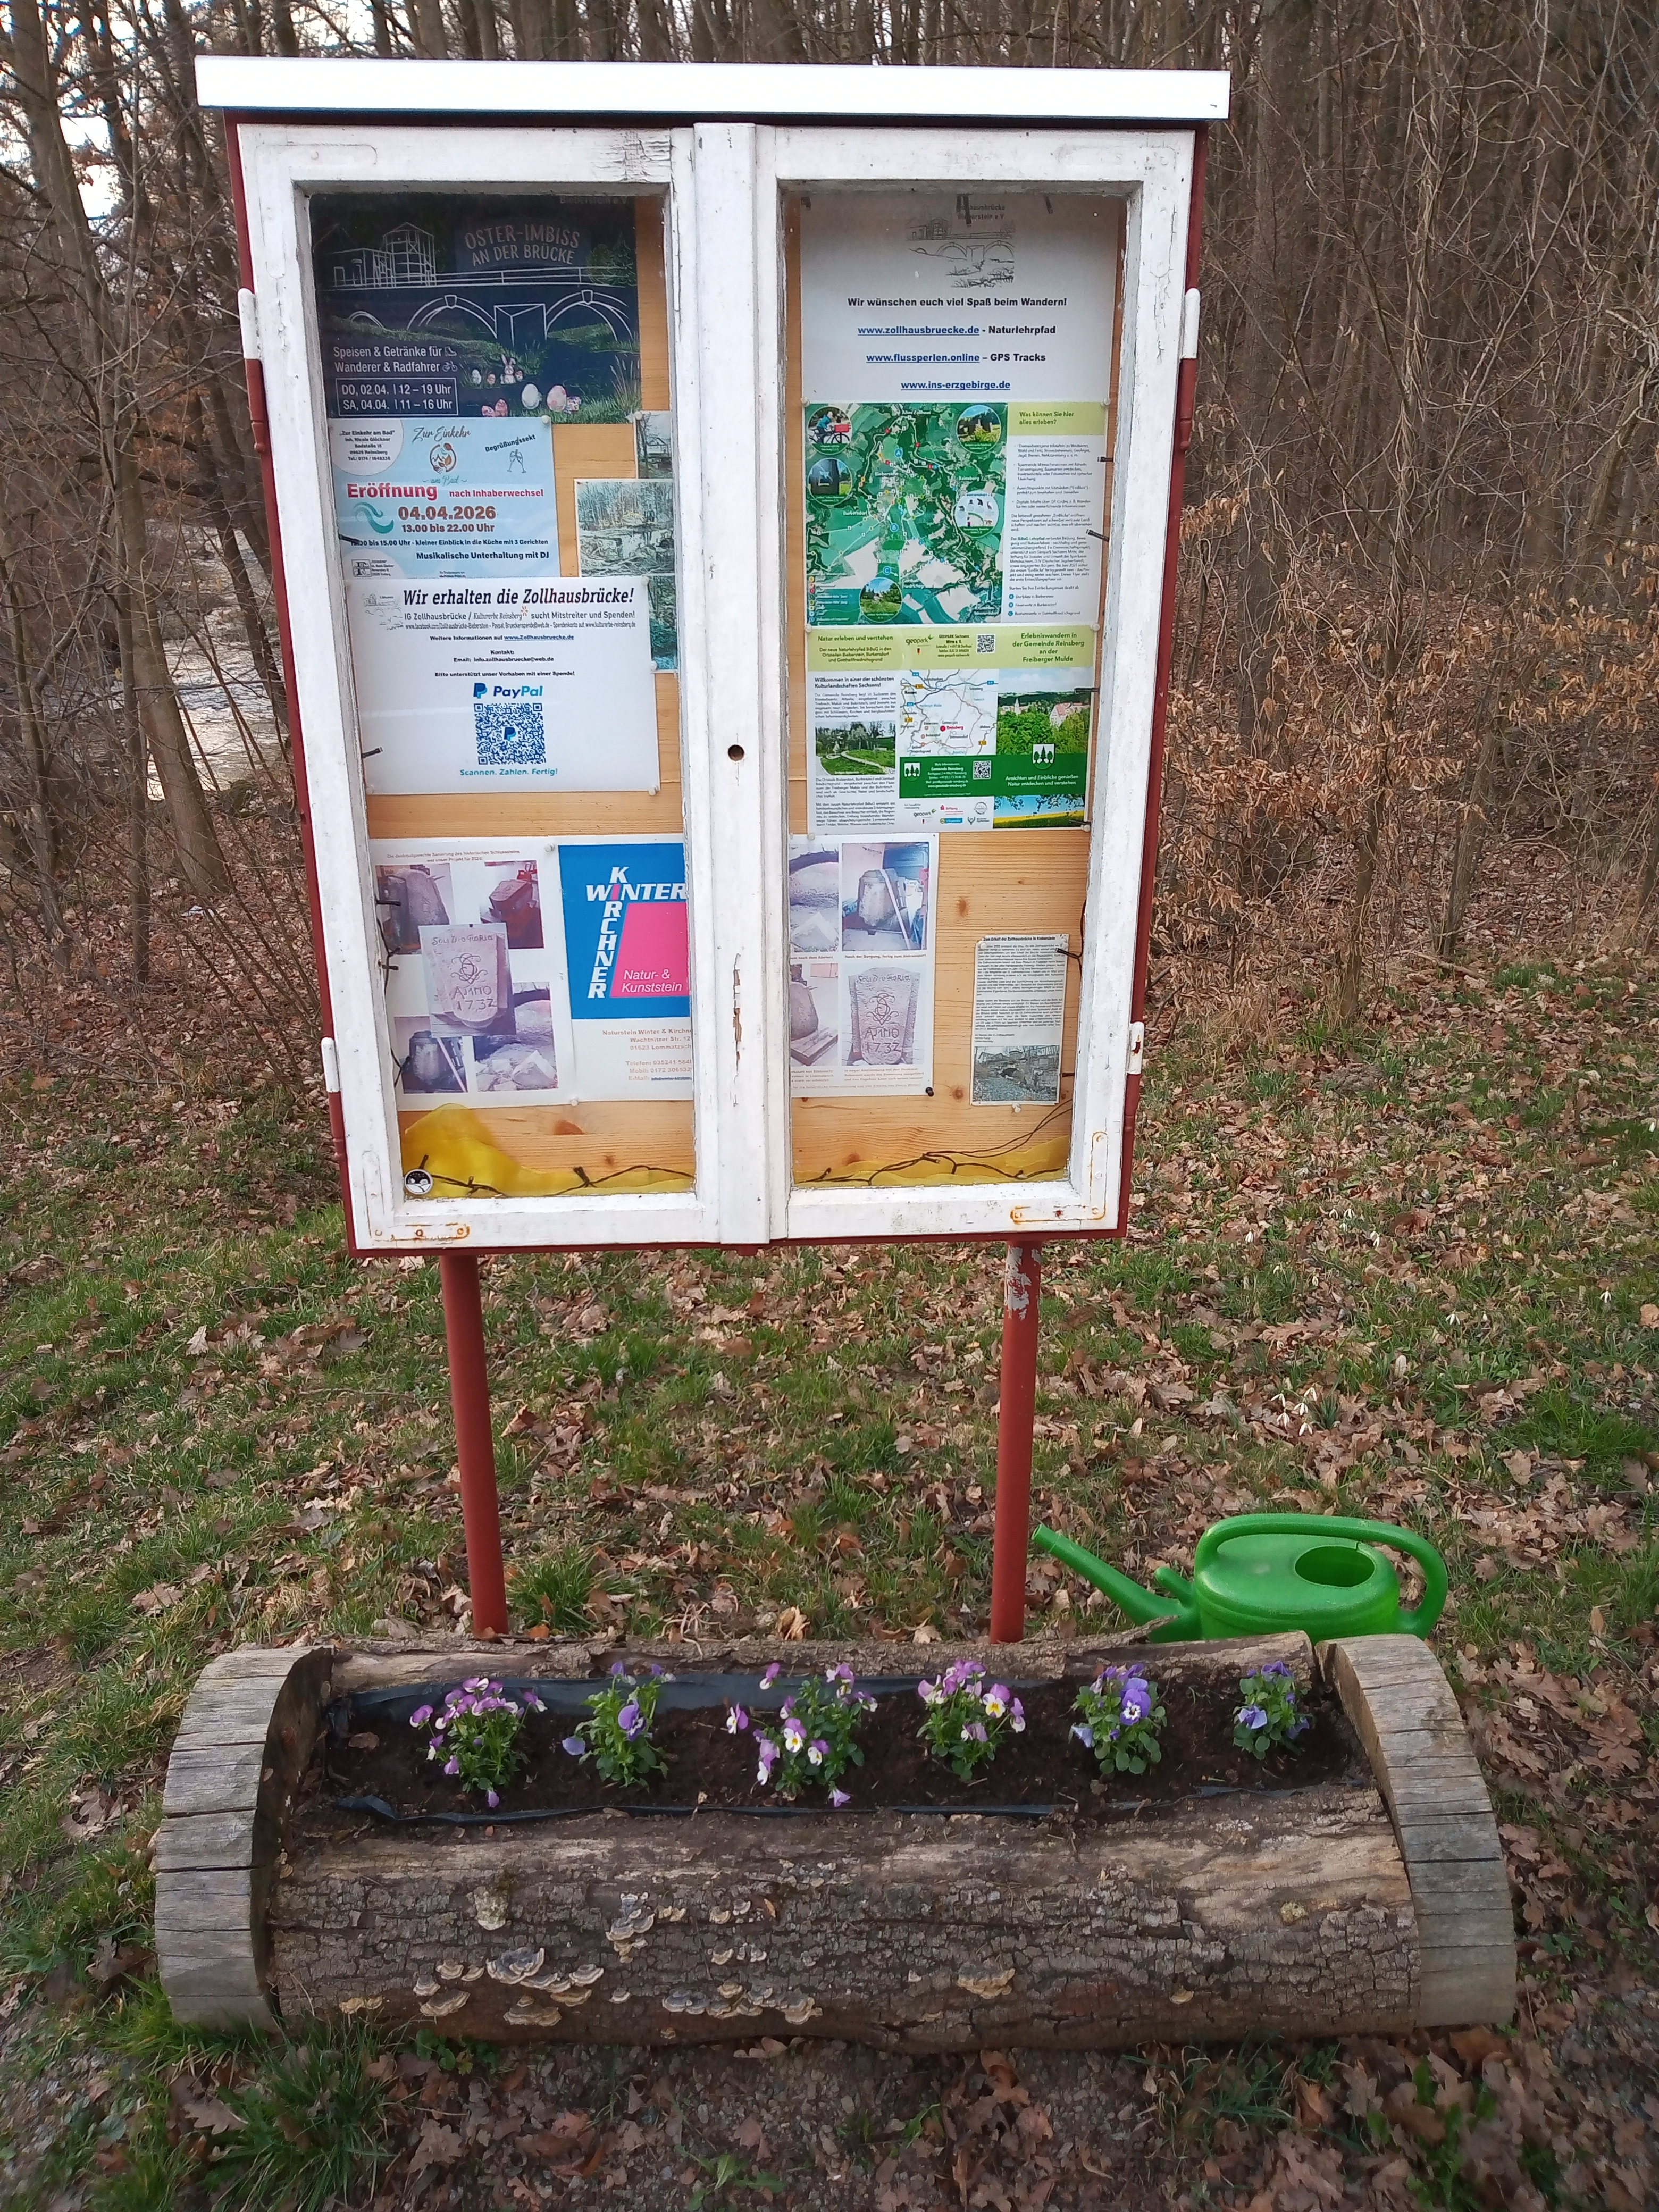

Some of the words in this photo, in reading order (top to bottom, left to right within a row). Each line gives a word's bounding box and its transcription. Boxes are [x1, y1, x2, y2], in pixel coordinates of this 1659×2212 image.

[465, 224, 580, 249] OSTER-IMBISS
[472, 249, 490, 266] AN
[493, 244, 519, 261] DER
[524, 242, 575, 265] BRÜCKE
[847, 297, 865, 307] Wir
[867, 297, 917, 307] wünschen
[919, 297, 944, 307] euch
[946, 297, 964, 306] viel
[967, 297, 991, 309] Spaß
[994, 297, 1018, 306] beim
[1020, 297, 1067, 306] Wandern!
[857, 325, 980, 336] www.zollhausbruecke.de
[988, 325, 1056, 337] Naturlehrpfad
[333, 346, 371, 359] Speisen
[374, 346, 381, 357] &
[384, 346, 426, 357] Getränke
[429, 346, 442, 357] für
[866, 353, 981, 364] www.flussperlen.online
[990, 353, 1010, 362] GPS
[1013, 353, 1046, 362] Tracks
[334, 362, 381, 372] Wanderer
[384, 362, 390, 372] &
[393, 362, 440, 372] Radfahrer
[342, 384, 358, 396] DO,
[361, 384, 389, 395] 02.04.
[399, 384, 410, 395] 12
[422, 384, 433, 395] 19
[435, 384, 451, 395] Uhr
[901, 381, 1011, 391] www.ins-erzgebirge.de
[343, 399, 359, 411] SA,
[361, 399, 390, 409] 04.04.
[400, 399, 410, 409] 11
[423, 399, 434, 409] 16
[437, 399, 453, 409] Uhr
[412, 426, 434, 444] Zur
[434, 425, 471, 442] Einkehr
[485, 434, 535, 452] Begrüßungssekt
[347, 482, 438, 501] Eröffnung
[473, 489, 543, 498] Inhaberwechsel
[398, 506, 496, 520] 04.04.2026
[402, 524, 426, 533] 13.00
[429, 523, 445, 532] bis
[447, 524, 475, 532] 22.00
[477, 523, 495, 532] Uhr
[471, 551, 523, 560] Unterhaltung
[403, 589, 428, 605] Wir
[432, 588, 492, 605] erhalten
[496, 588, 518, 604] die
[523, 586, 634, 604] Zollhausbrücke!
[604, 611, 635, 619] Spenden!
[493, 685, 543, 699] PayPal
[586, 883, 687, 901] WINTER
[587, 866, 629, 999] KIRCHNER
[624, 969, 659, 980] Natur-
[662, 969, 671, 980] &
[621, 982, 682, 993] Kunststein
[457, 999, 498, 1011] 1732
[867, 1042, 901, 1054] 1732
